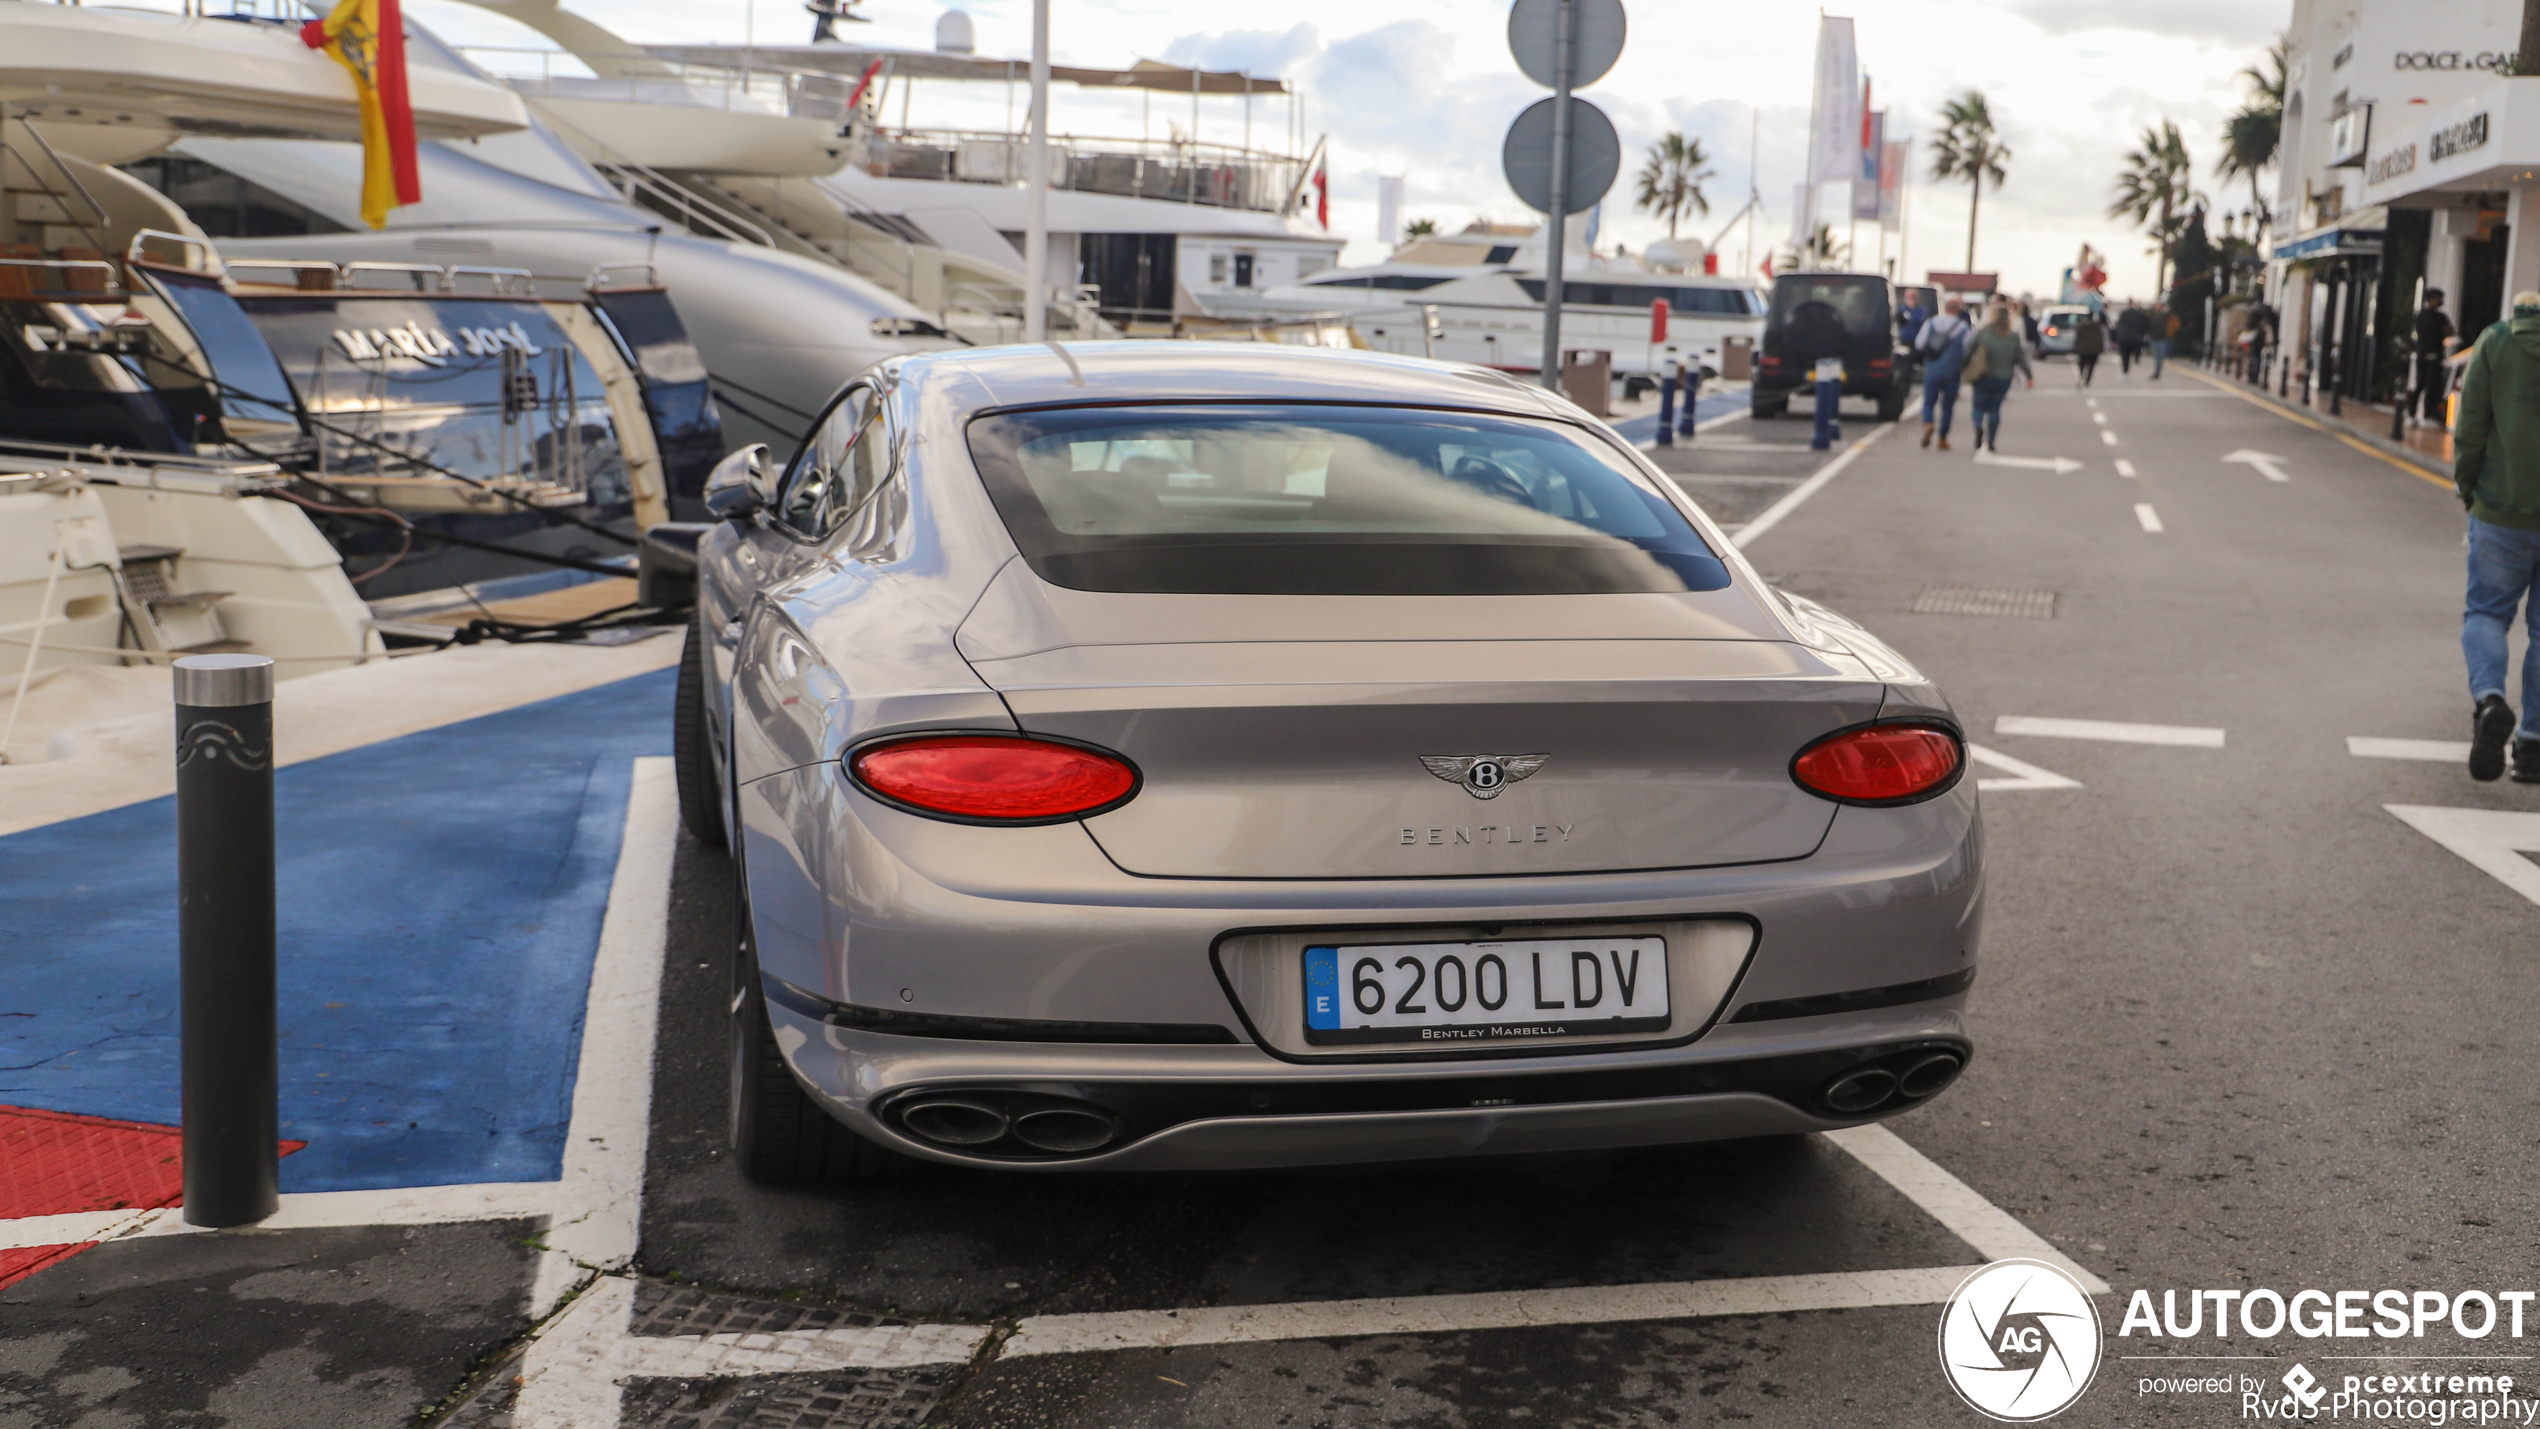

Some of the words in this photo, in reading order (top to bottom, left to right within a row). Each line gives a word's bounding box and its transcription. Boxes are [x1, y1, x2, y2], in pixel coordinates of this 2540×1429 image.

[2395, 51, 2461, 70] DOLCE
[1400, 824, 1573, 845] BENTLEY
[1352, 953, 1508, 1015] 6200
[1531, 950, 1640, 1010] LDV
[1316, 996, 1330, 1013] E
